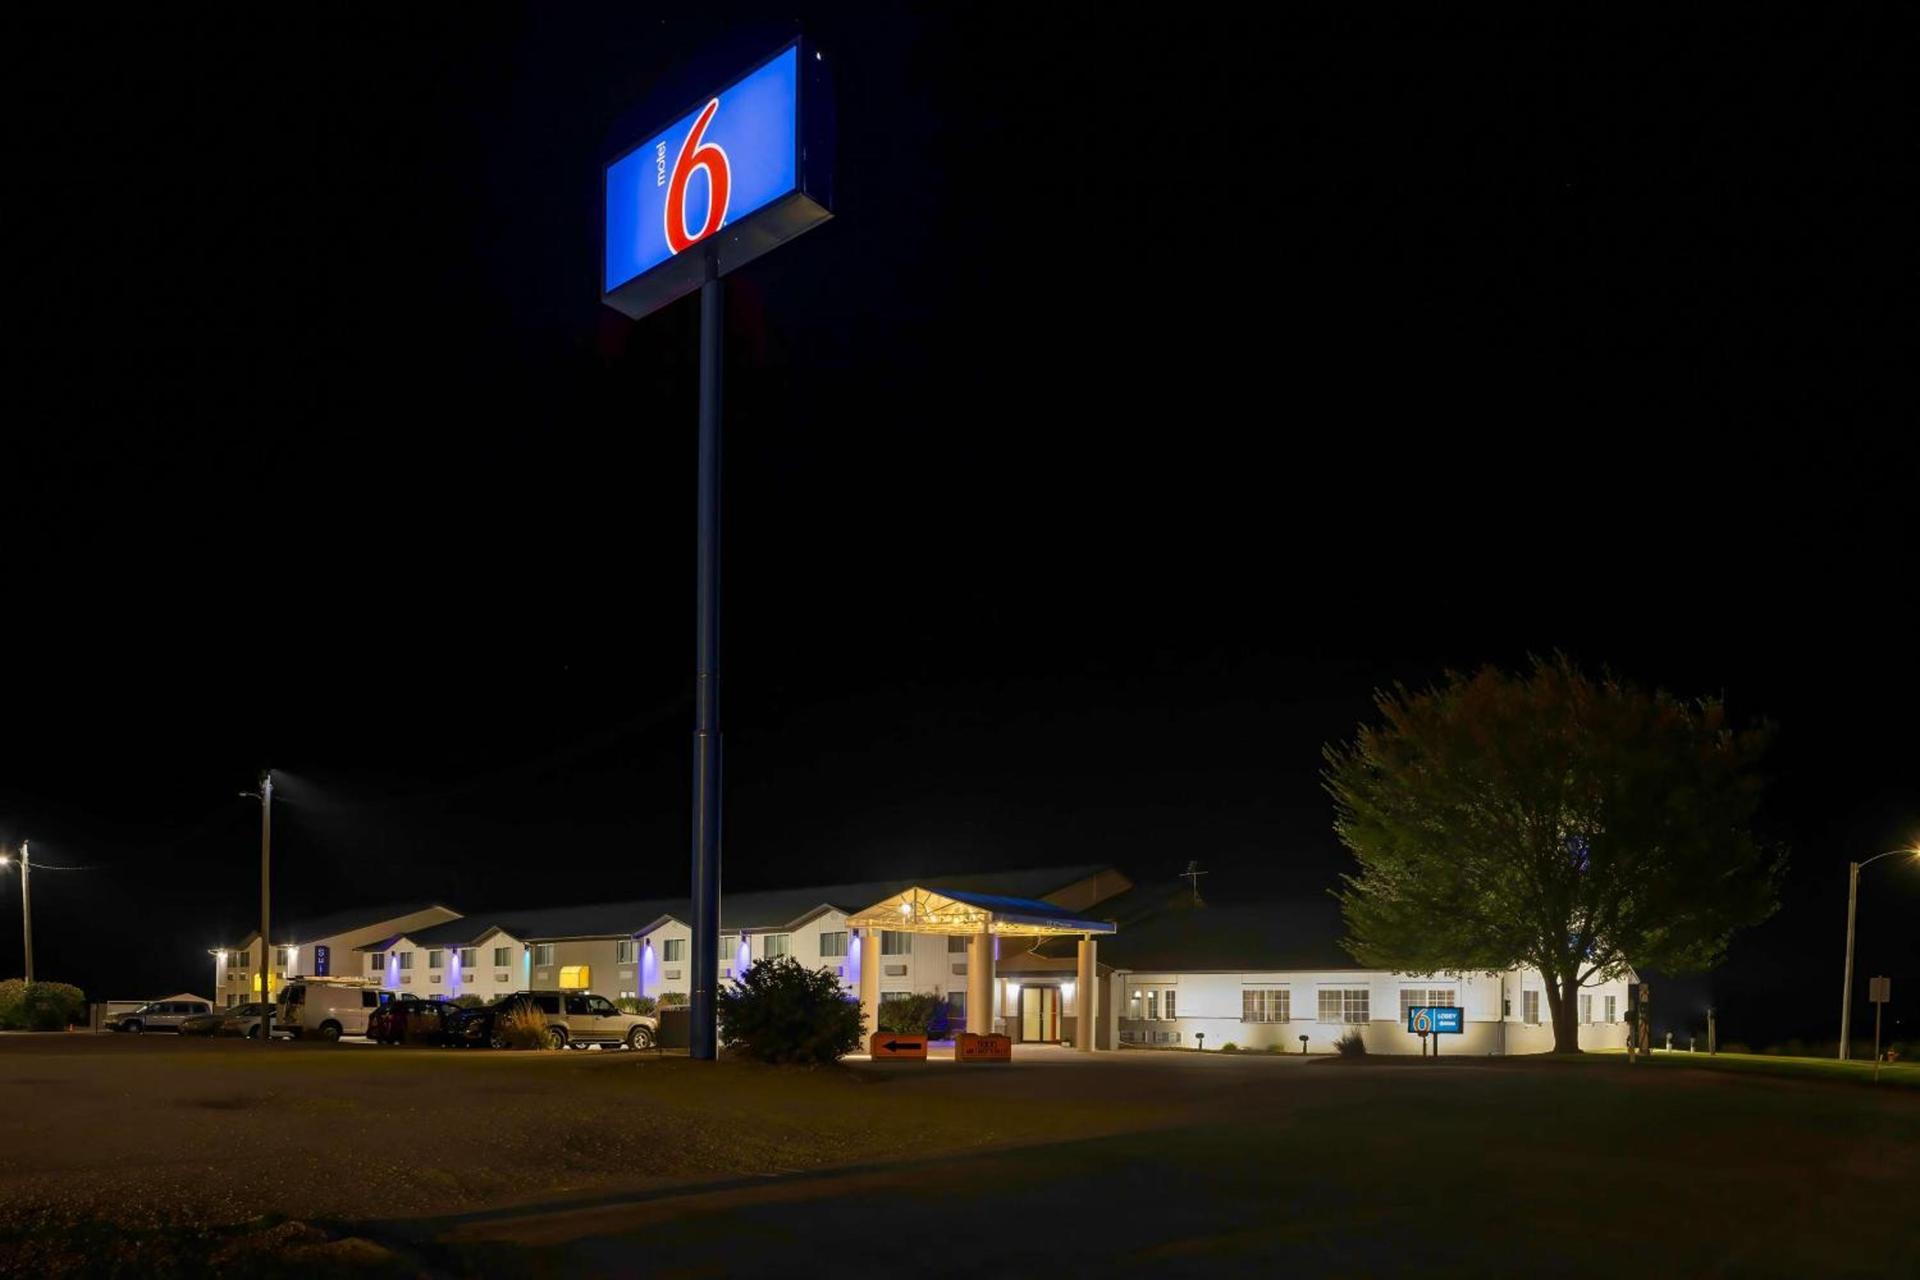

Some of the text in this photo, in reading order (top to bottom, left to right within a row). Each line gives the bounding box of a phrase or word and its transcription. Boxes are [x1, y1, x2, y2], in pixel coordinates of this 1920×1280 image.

[656, 97, 732, 255] motel 6
[1413, 1008, 1432, 1033] 6
